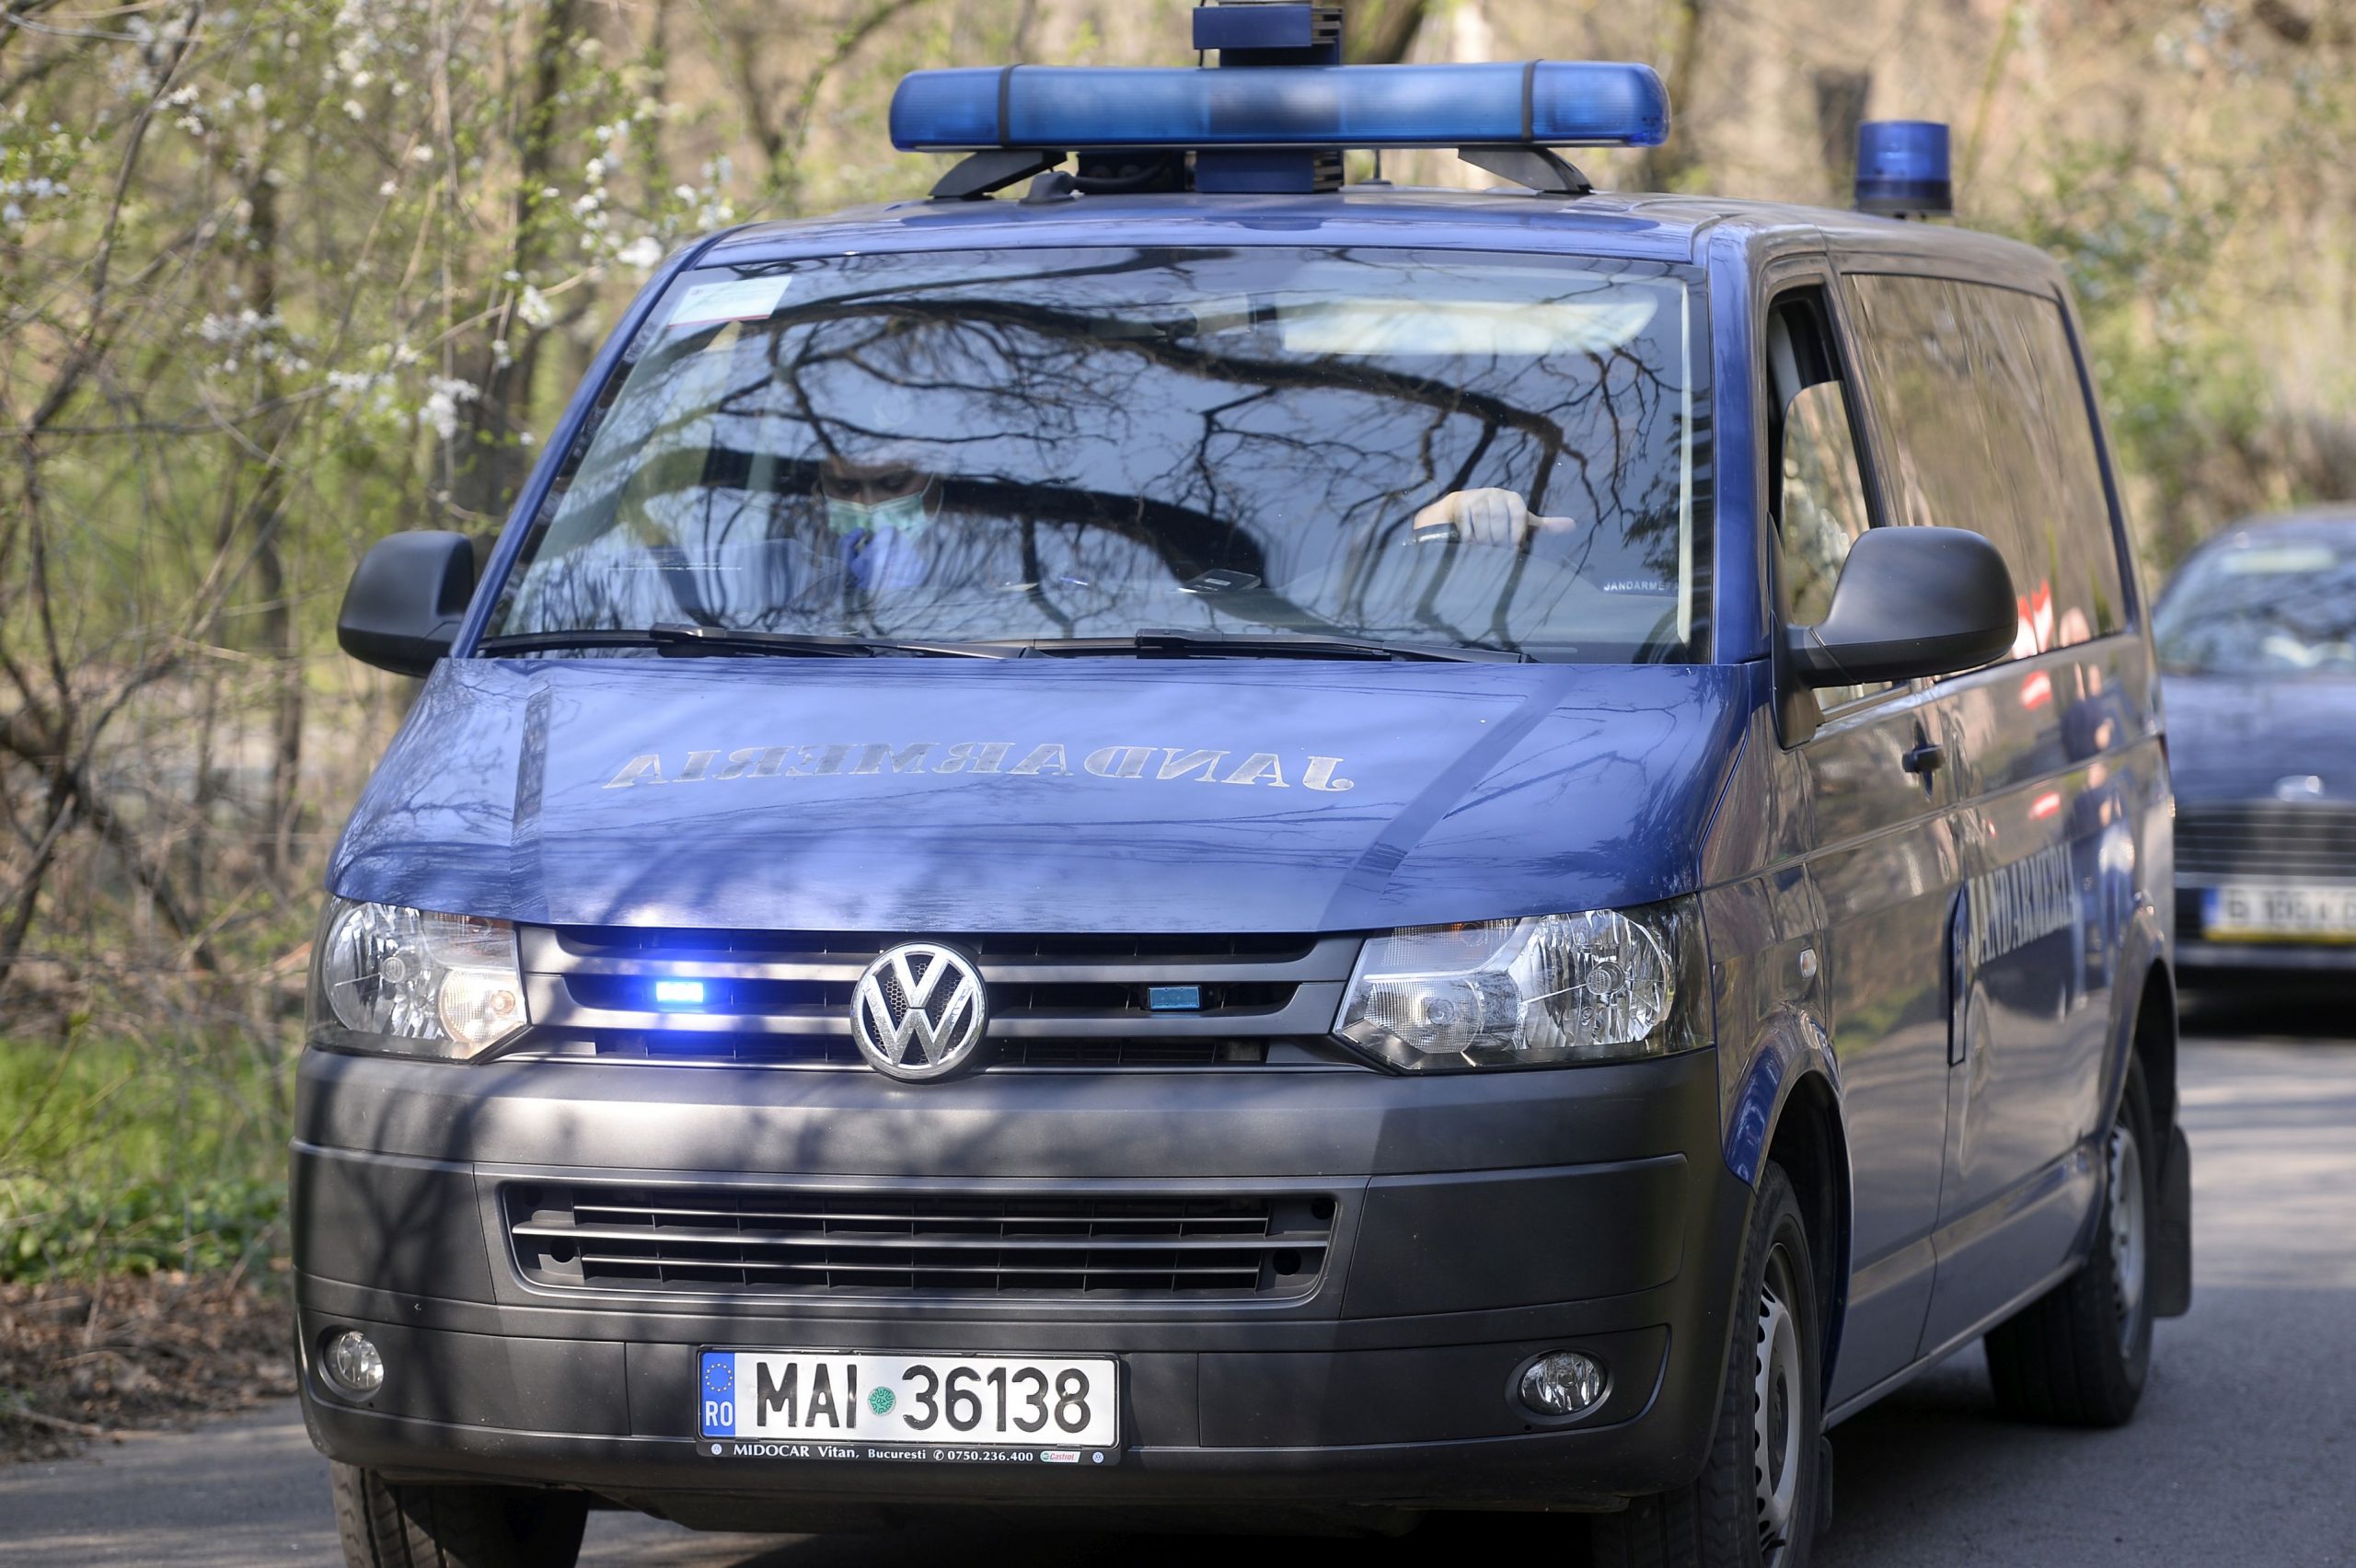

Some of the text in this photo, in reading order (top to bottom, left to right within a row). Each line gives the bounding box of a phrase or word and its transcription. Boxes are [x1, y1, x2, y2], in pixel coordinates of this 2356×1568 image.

[705, 1361, 1091, 1434] RO MAI 36138
[733, 1444, 810, 1458] MIDOCAR
[817, 1446, 860, 1459] Vitan,
[868, 1448, 927, 1460] Bucuresti
[947, 1450, 1034, 1462] 0750.236.400
[1049, 1452, 1075, 1462] Castrol
